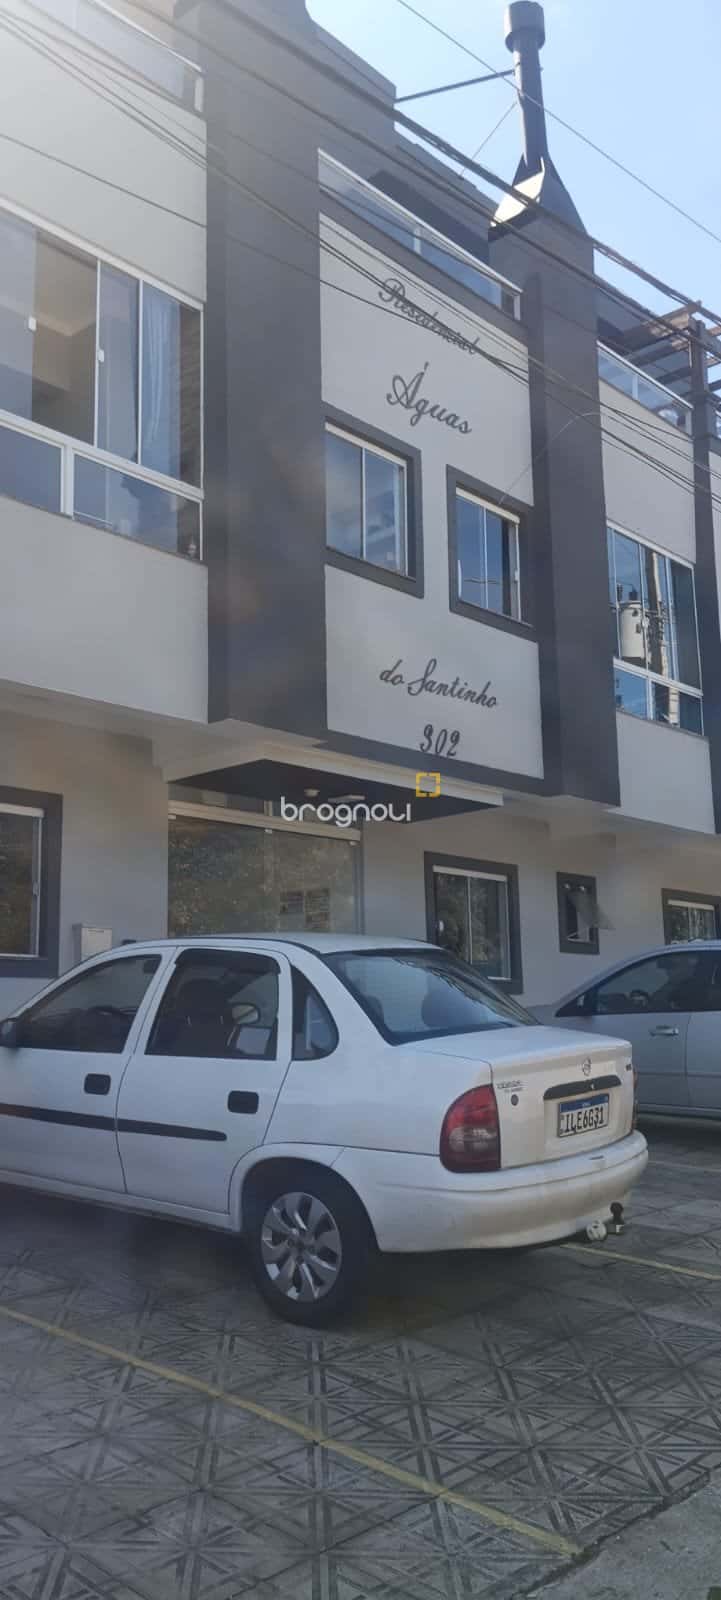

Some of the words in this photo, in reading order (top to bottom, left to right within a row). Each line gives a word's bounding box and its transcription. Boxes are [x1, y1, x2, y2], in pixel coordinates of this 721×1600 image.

[386, 361, 472, 434] Águas
[379, 659, 404, 686] do
[407, 658, 498, 708] Santinho
[420, 723, 461, 757] 302
[564, 1105, 605, 1133] ILE6G31
